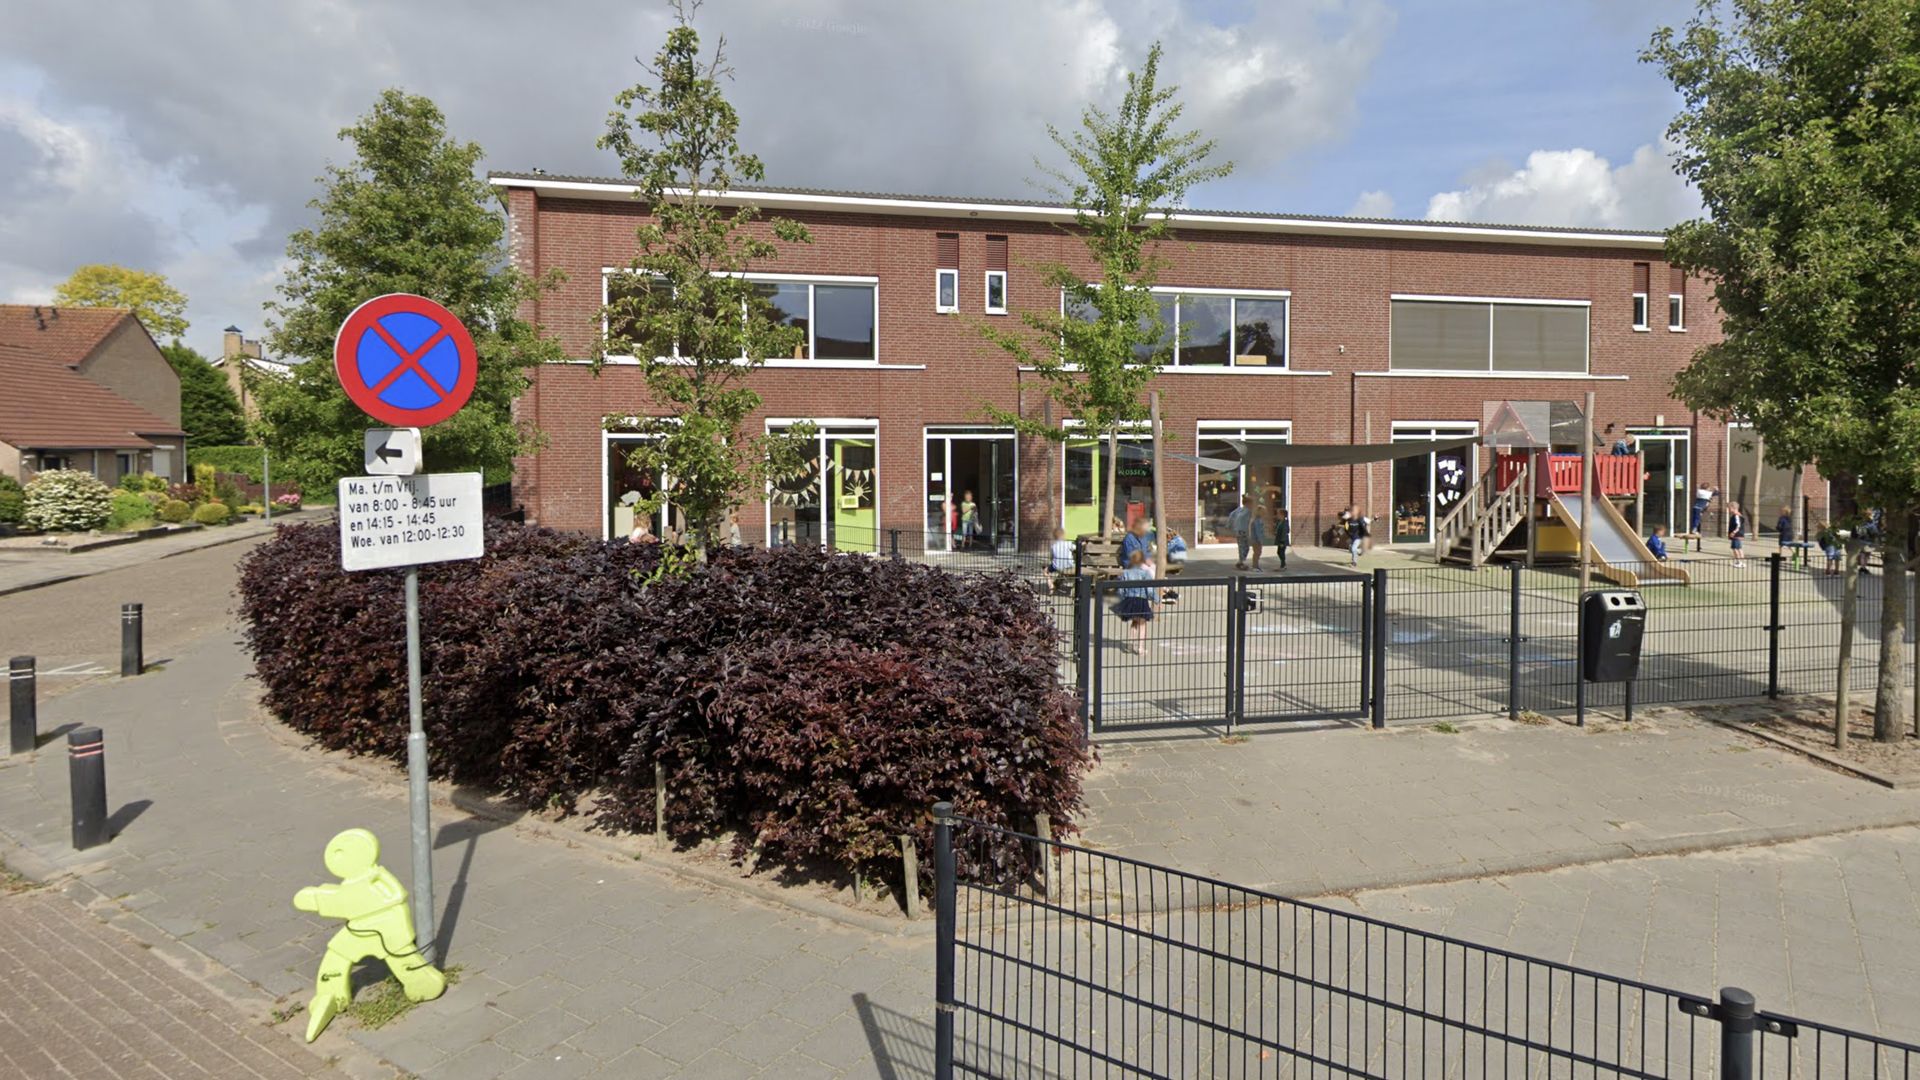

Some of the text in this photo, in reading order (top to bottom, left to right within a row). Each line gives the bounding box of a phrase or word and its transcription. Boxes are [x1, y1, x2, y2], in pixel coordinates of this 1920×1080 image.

[349, 479, 419, 496] Ma. t/m Vrij.
[349, 503, 369, 513] van
[373, 498, 399, 512] 8:00
[412, 496, 436, 510] 8:45
[439, 497, 456, 508] uur
[350, 521, 363, 532] en
[367, 515, 394, 530] 14:15
[407, 512, 436, 527] 14:45
[351, 525, 465, 548] Woe. van 12:00-12:30
